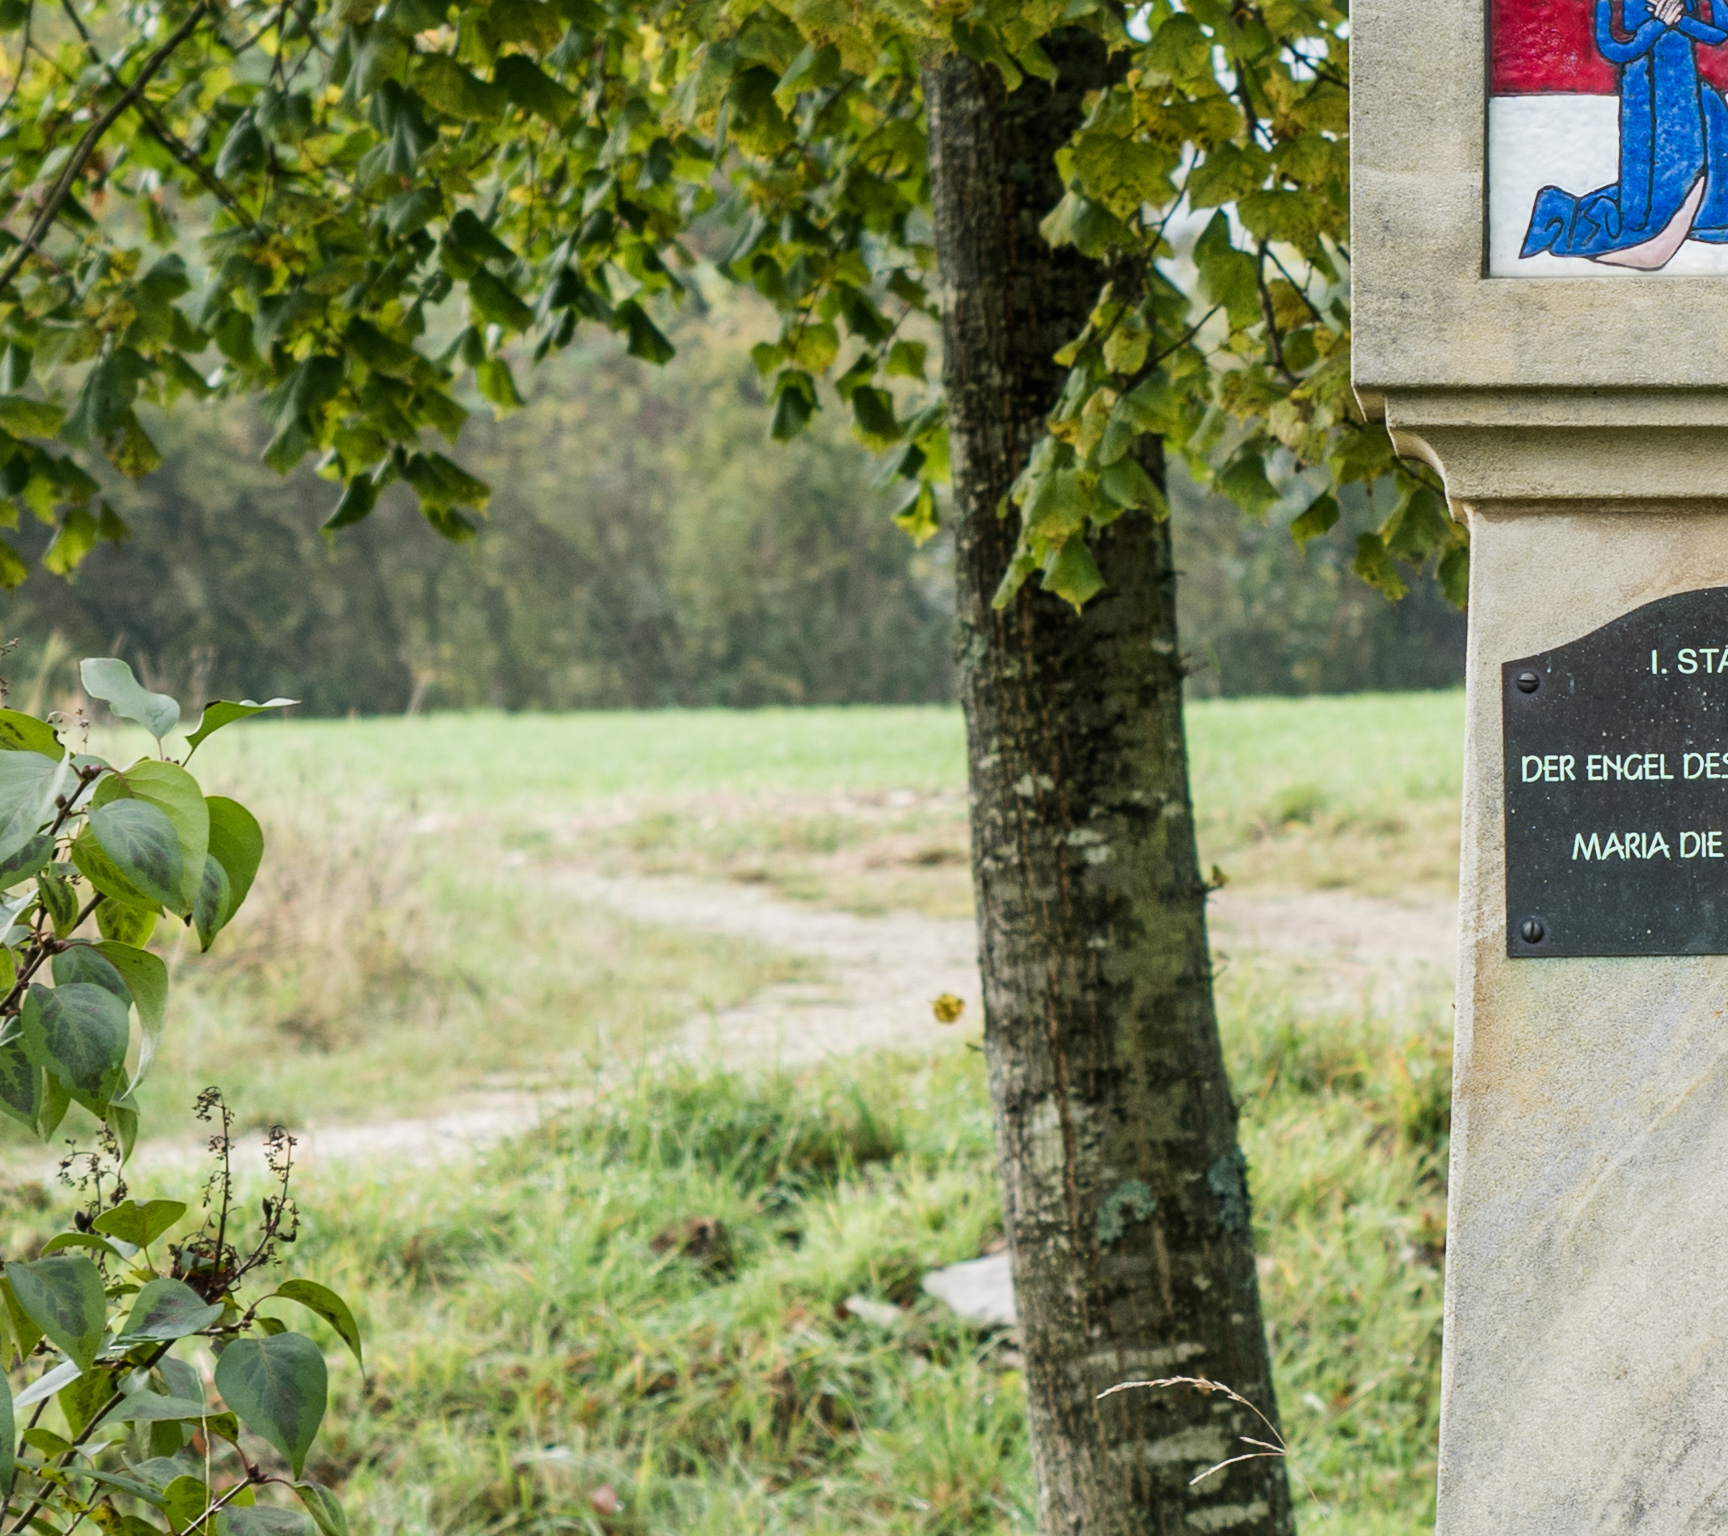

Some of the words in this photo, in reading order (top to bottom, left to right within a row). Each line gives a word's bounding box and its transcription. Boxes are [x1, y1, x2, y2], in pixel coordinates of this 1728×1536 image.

[1649, 650, 1668, 675] I.
[1521, 754, 1577, 783] DER
[1585, 753, 1675, 782] ENGEL
[1571, 831, 1671, 861] MARIA
[1679, 830, 1725, 859] DIE
